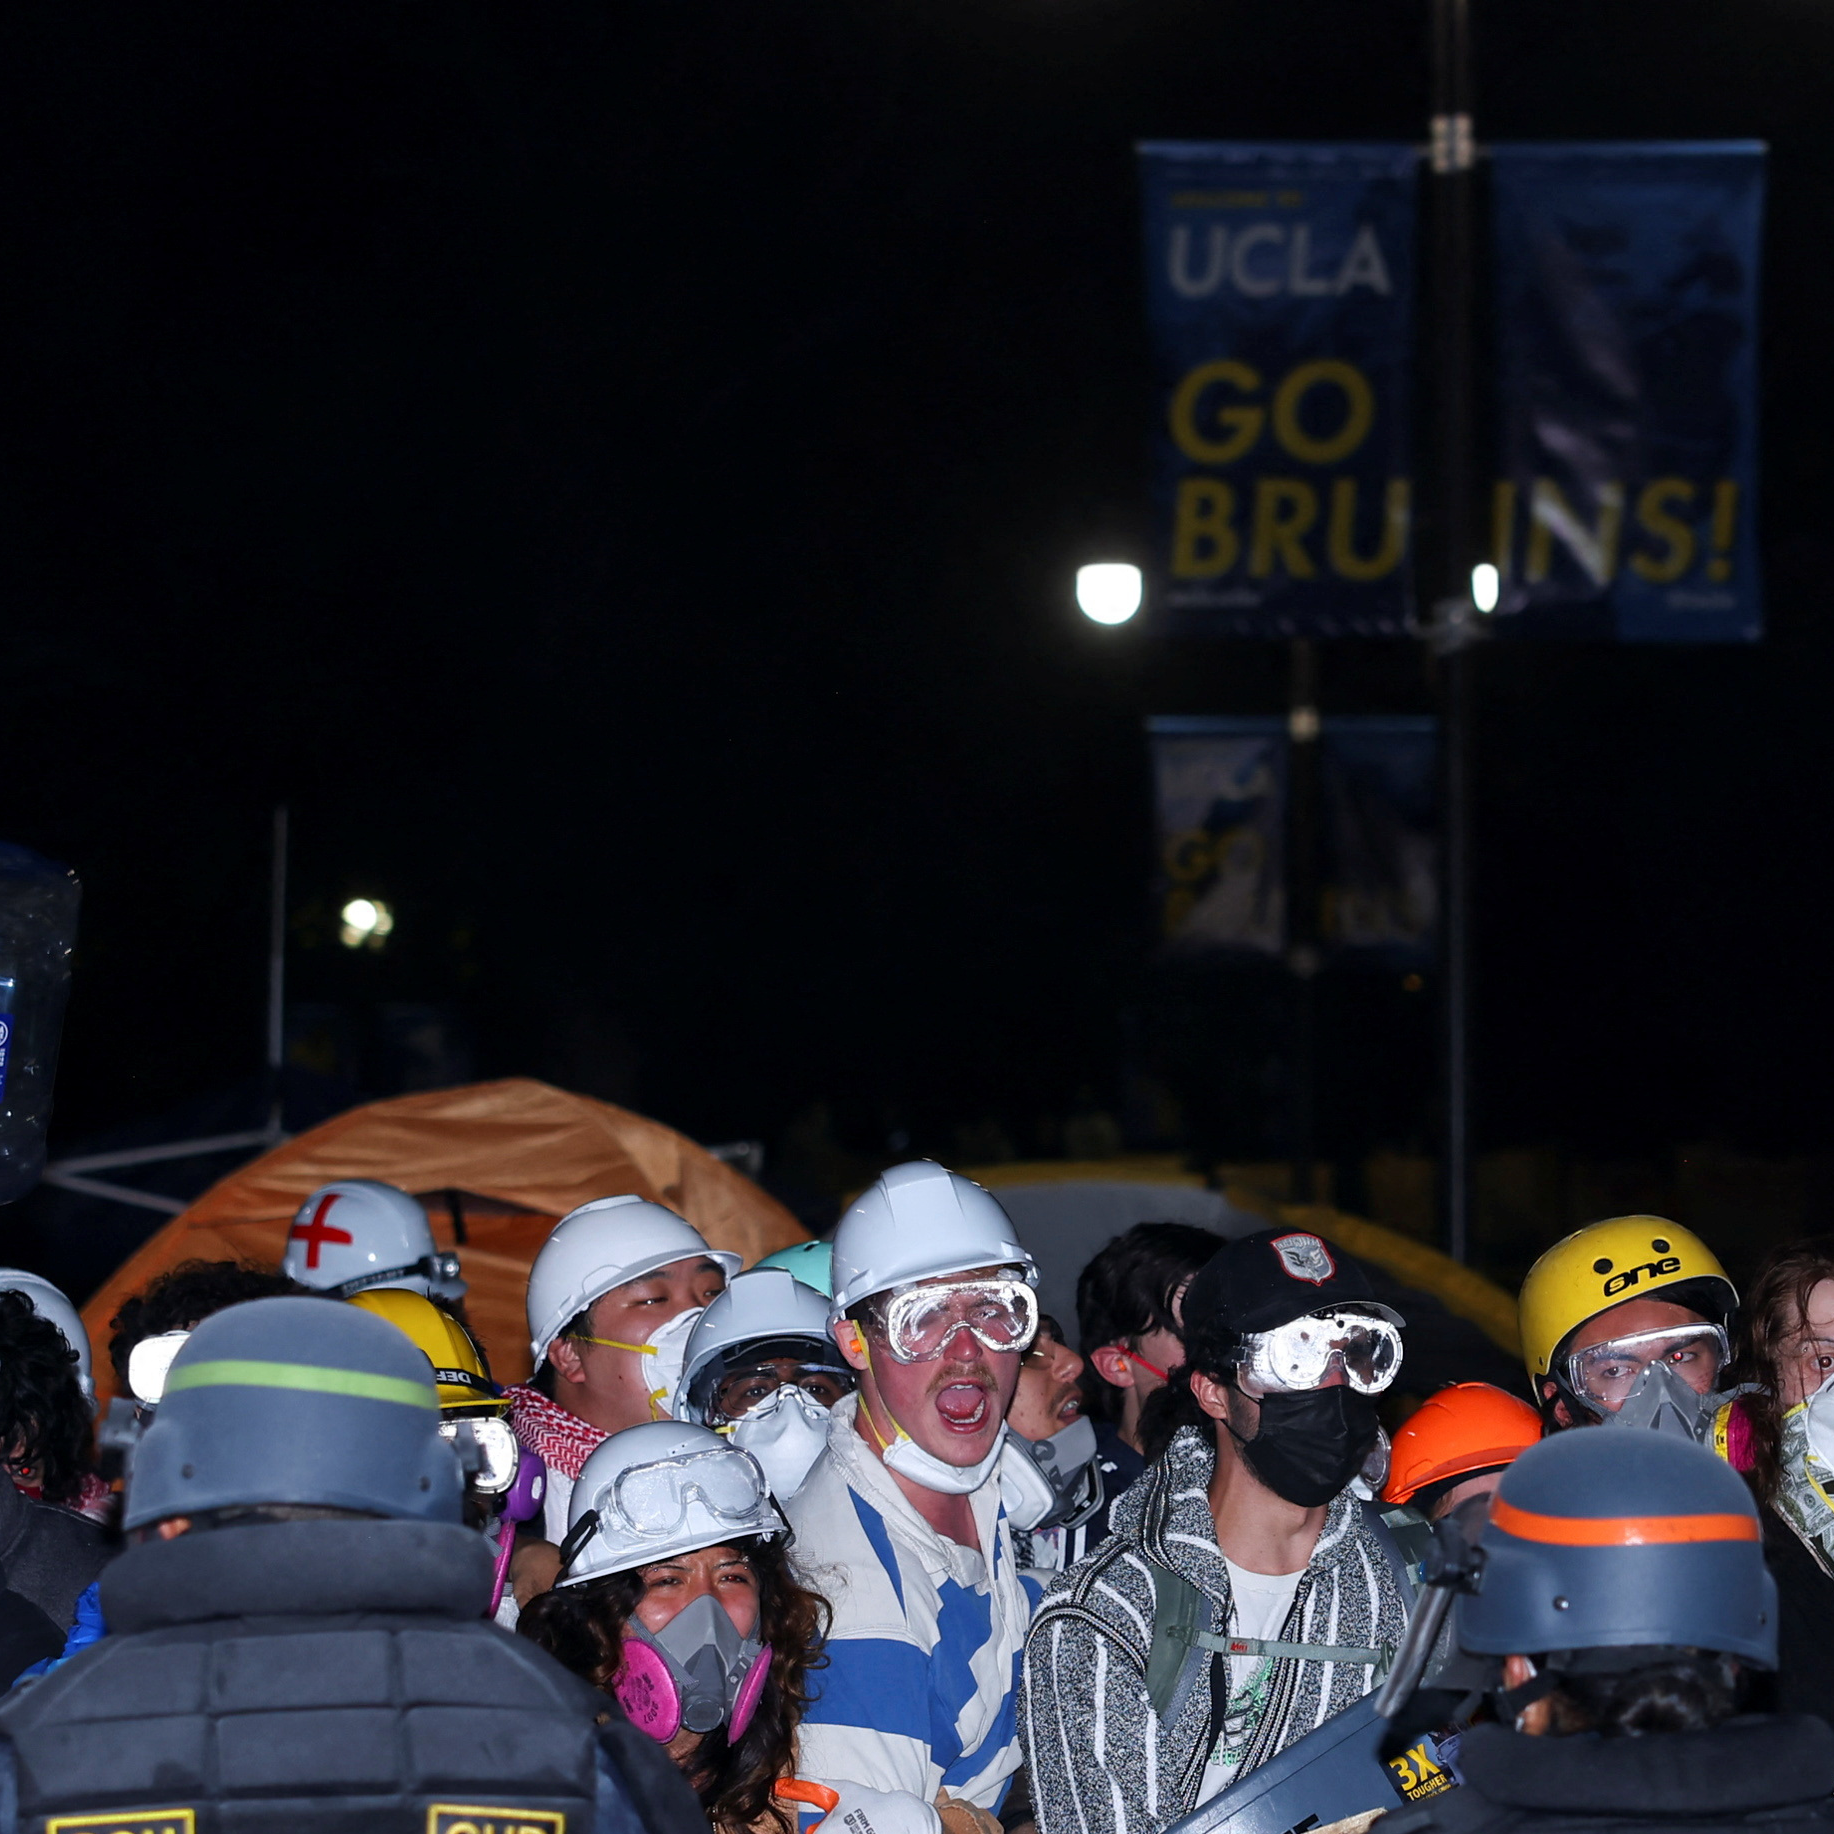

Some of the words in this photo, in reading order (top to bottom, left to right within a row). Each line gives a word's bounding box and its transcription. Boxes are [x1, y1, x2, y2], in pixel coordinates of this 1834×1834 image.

[1166, 222, 1392, 300] UCLA
[1167, 358, 1375, 466] GO
[1389, 1744, 1441, 1791] 3X
[1407, 1774, 1448, 1801] TOUGHER
[854, 1808, 870, 1829] FIRM
